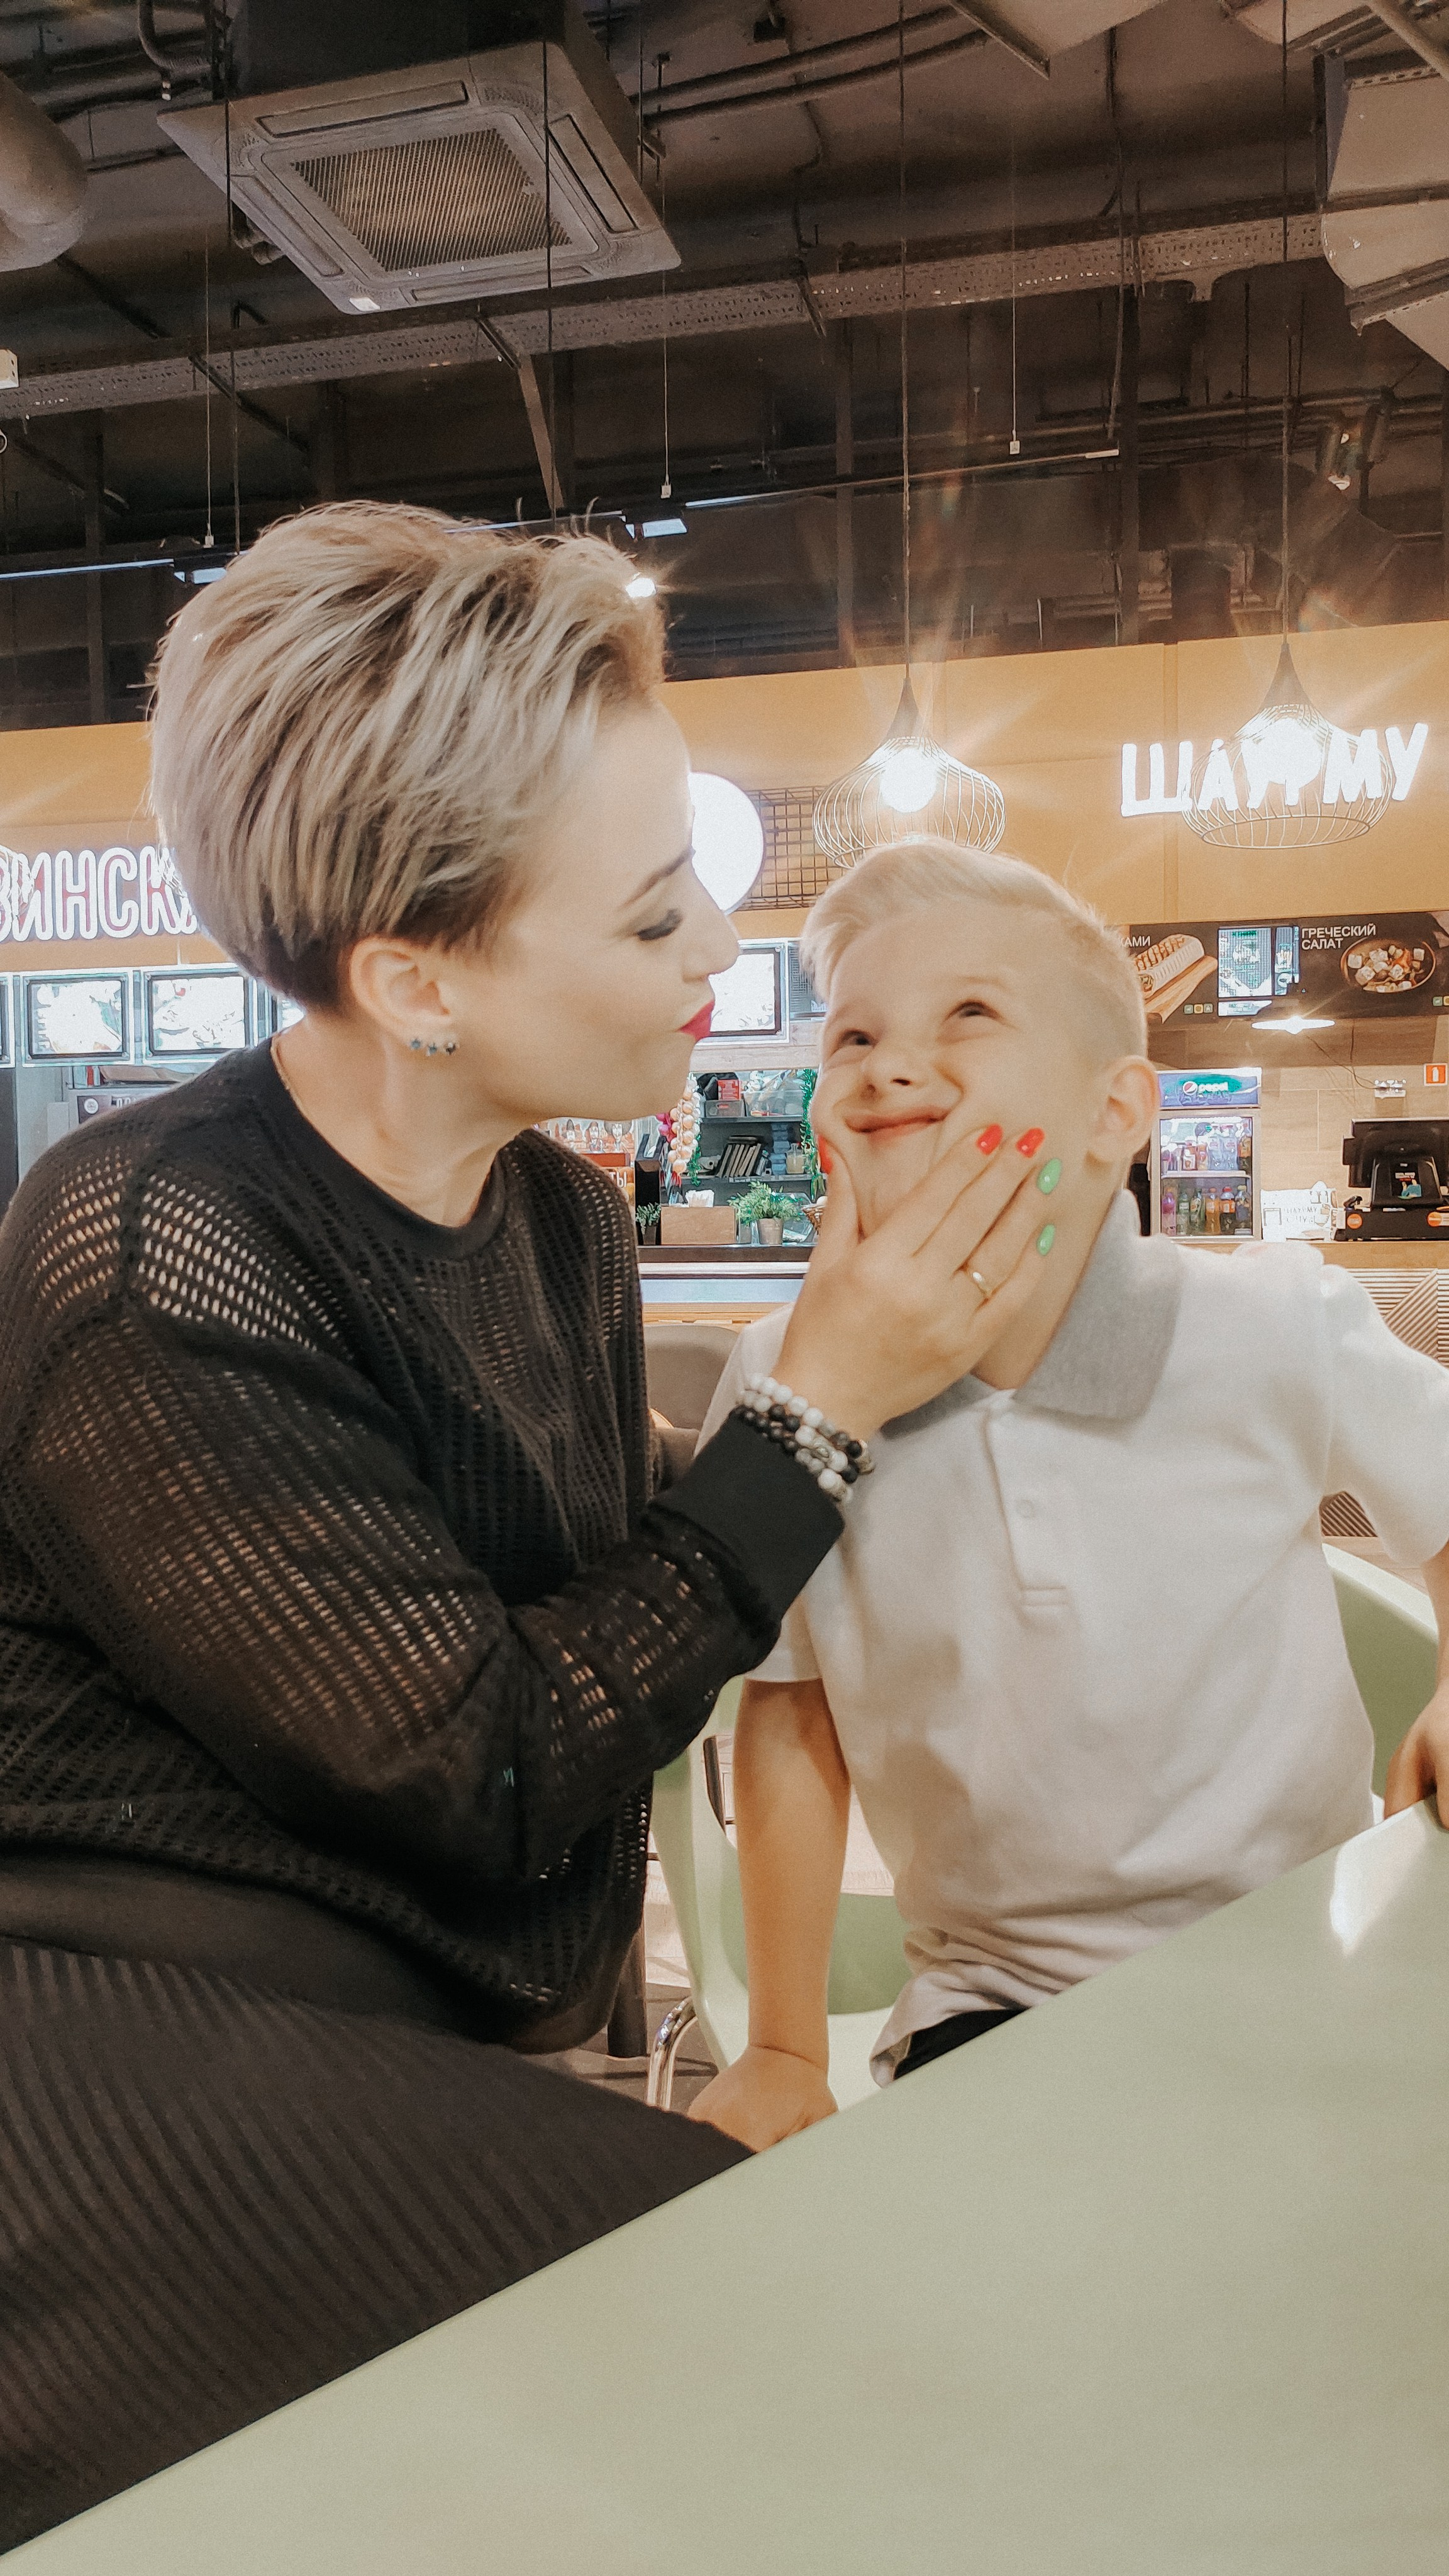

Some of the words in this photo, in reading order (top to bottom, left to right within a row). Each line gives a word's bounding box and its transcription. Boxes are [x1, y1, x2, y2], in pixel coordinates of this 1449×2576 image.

[0, 846, 197, 942] ИНСК
[1301, 923, 1376, 938] ГРЕЧЕСКИЙ
[1301, 938, 1344, 950] САЛАТ
